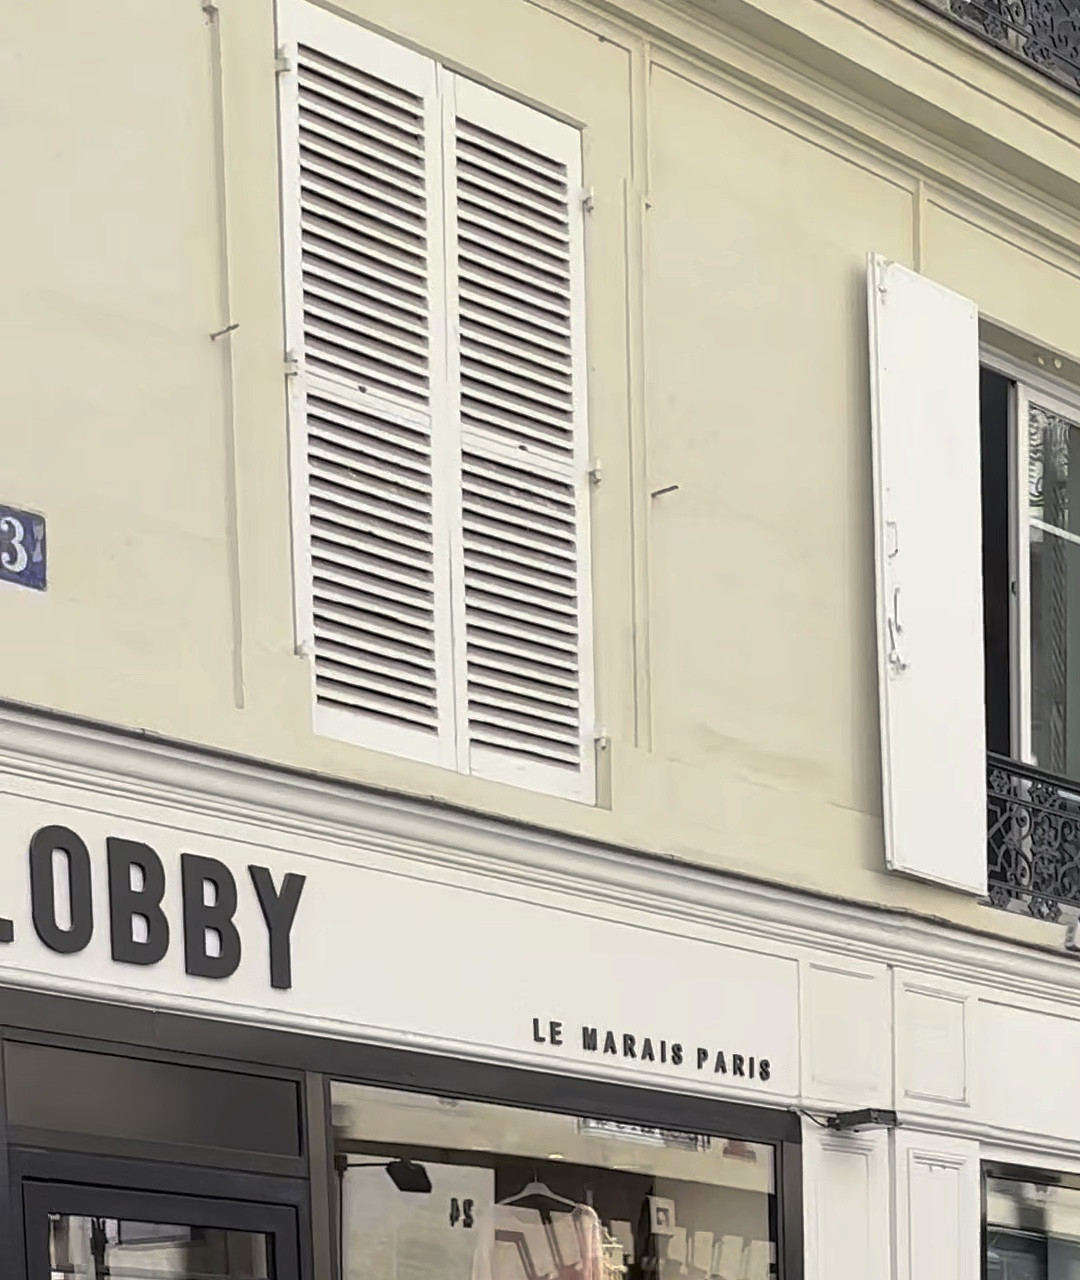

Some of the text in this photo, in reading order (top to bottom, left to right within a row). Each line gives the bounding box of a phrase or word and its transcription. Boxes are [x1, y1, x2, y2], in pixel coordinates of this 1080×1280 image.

[1, 516, 28, 572] 3
[0, 824, 306, 990] OBBY
[533, 1018, 771, 1081] LE MARAIS PARIS
